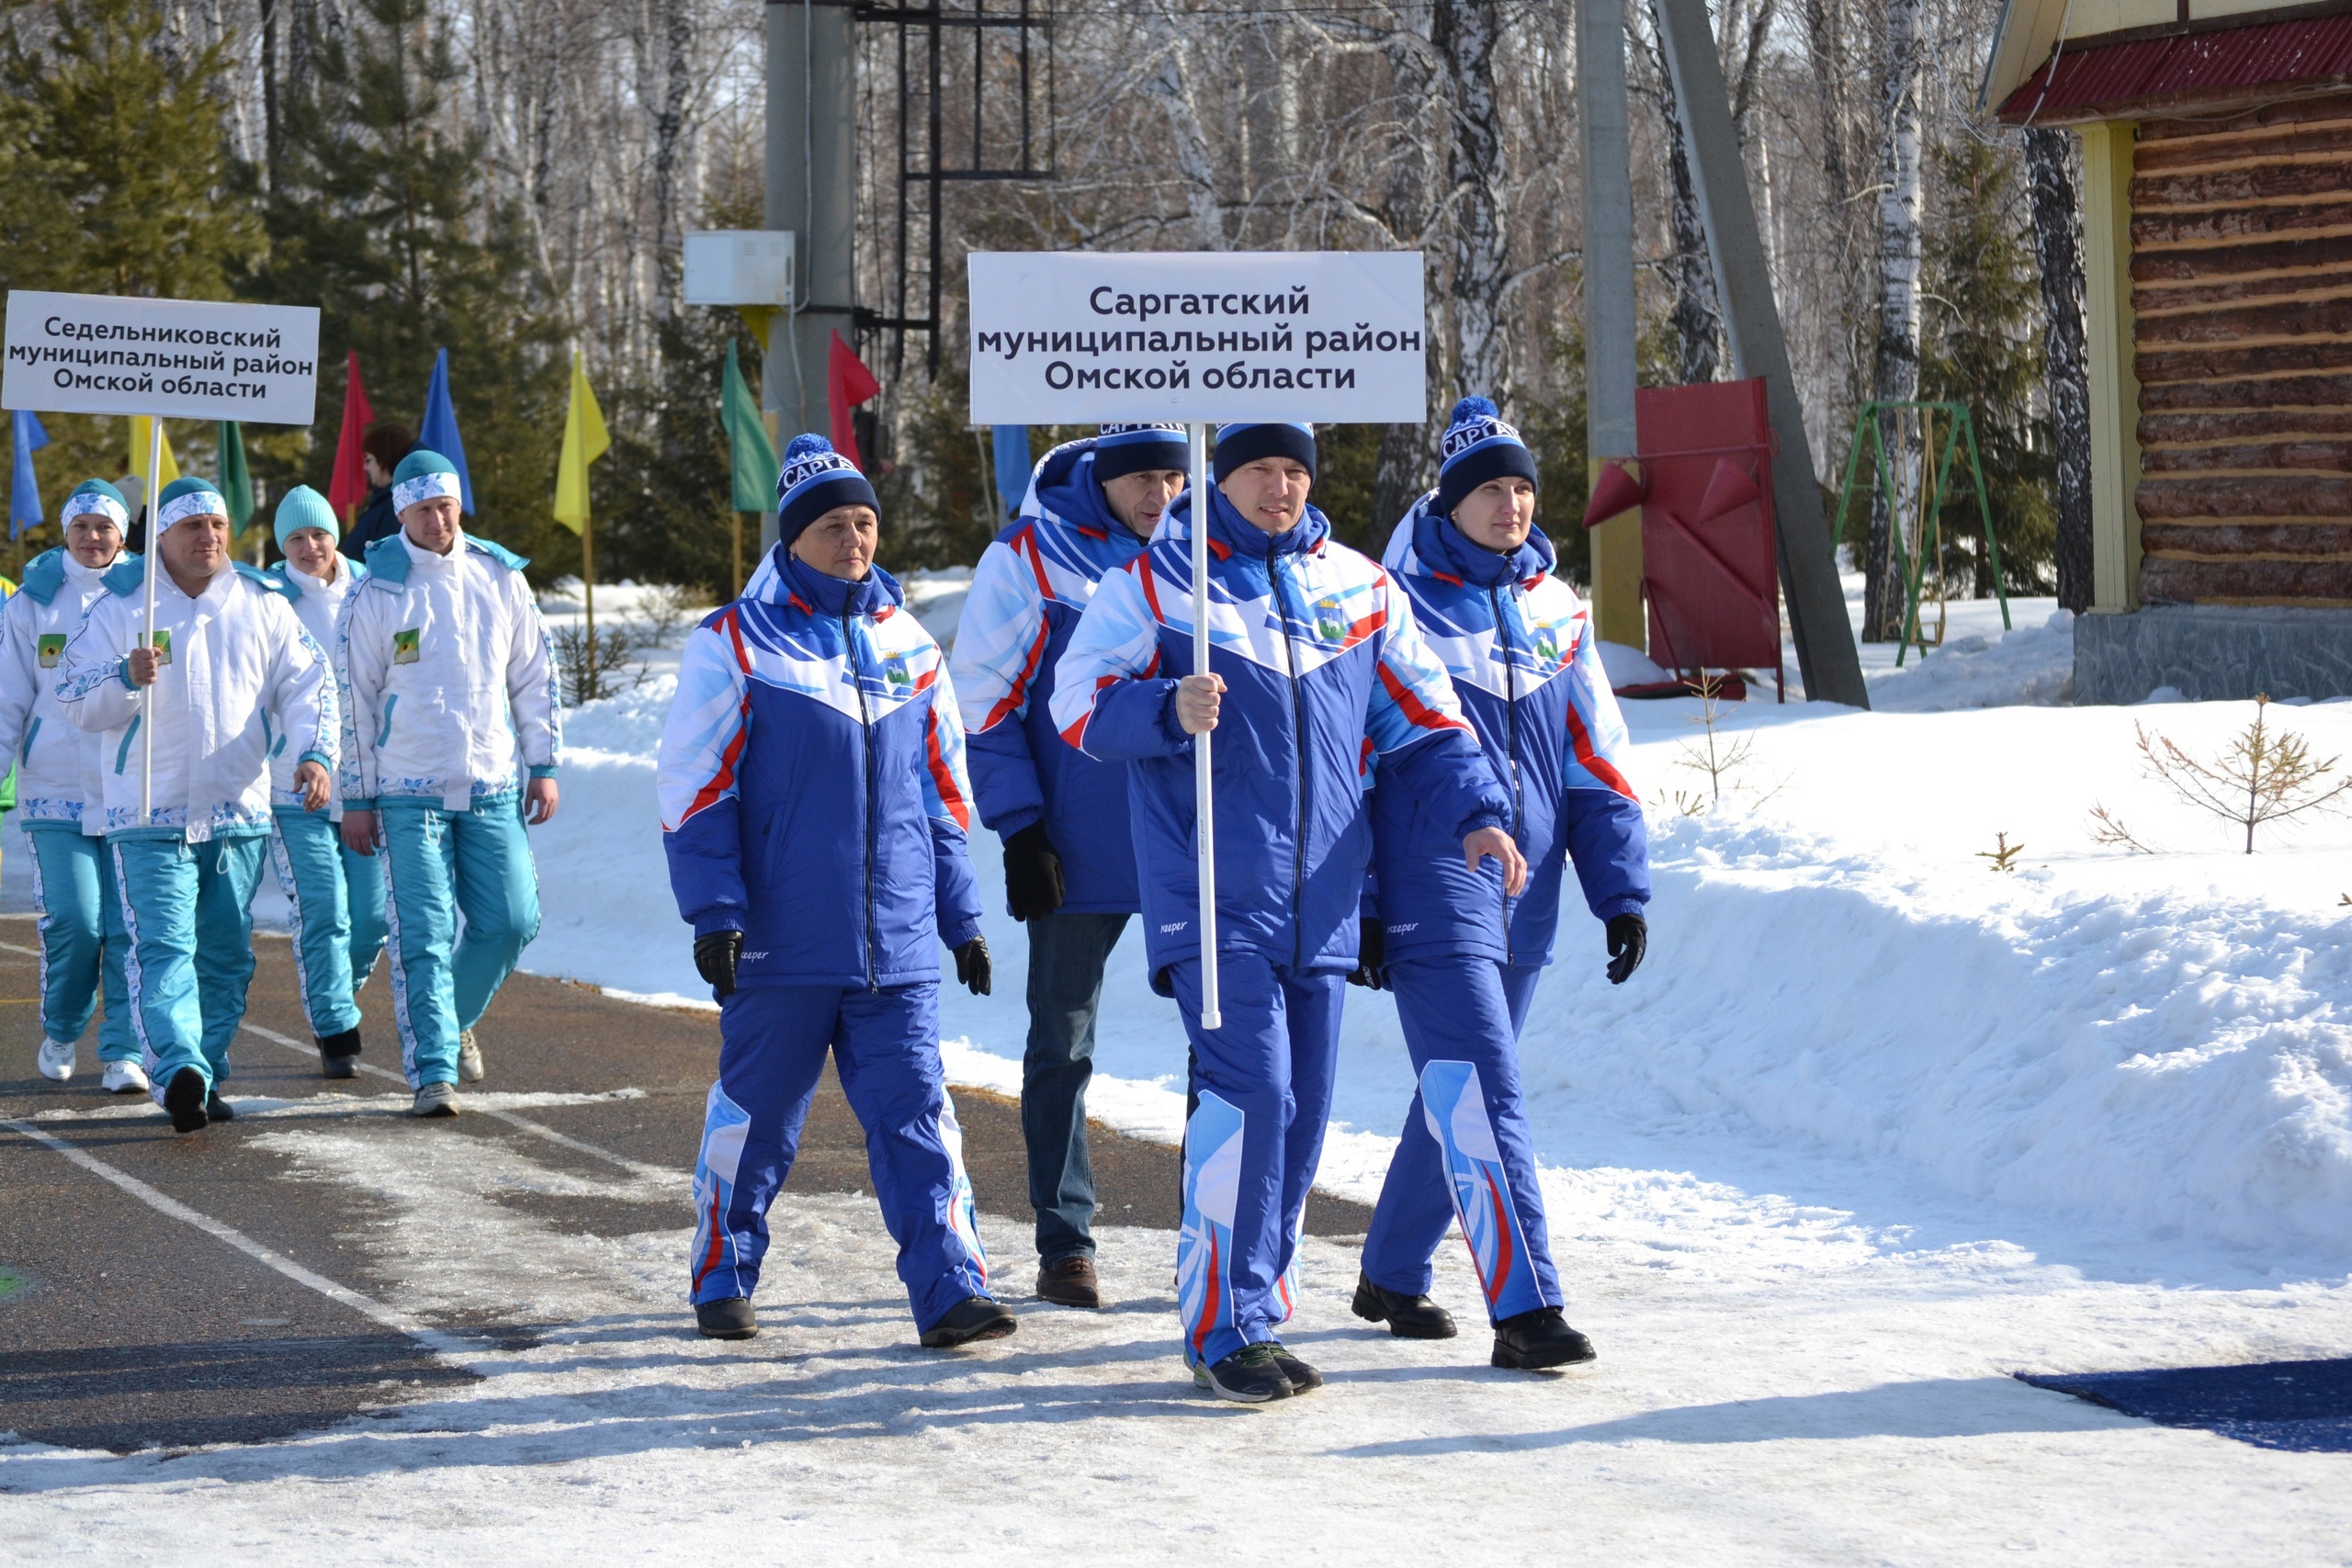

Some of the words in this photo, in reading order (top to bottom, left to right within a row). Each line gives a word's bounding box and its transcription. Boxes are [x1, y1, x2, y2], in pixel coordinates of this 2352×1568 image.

[1090, 285, 1309, 322] Саргатский
[44, 316, 281, 349] Седельниковский
[978, 321, 1293, 360] муниципальный
[1306, 322, 1420, 359] район
[9, 344, 225, 371] муниципальный
[232, 353, 312, 378] район
[1045, 359, 1189, 390] Омской
[1202, 360, 1355, 390] области
[53, 367, 153, 393] Омской
[161, 374, 266, 399] области
